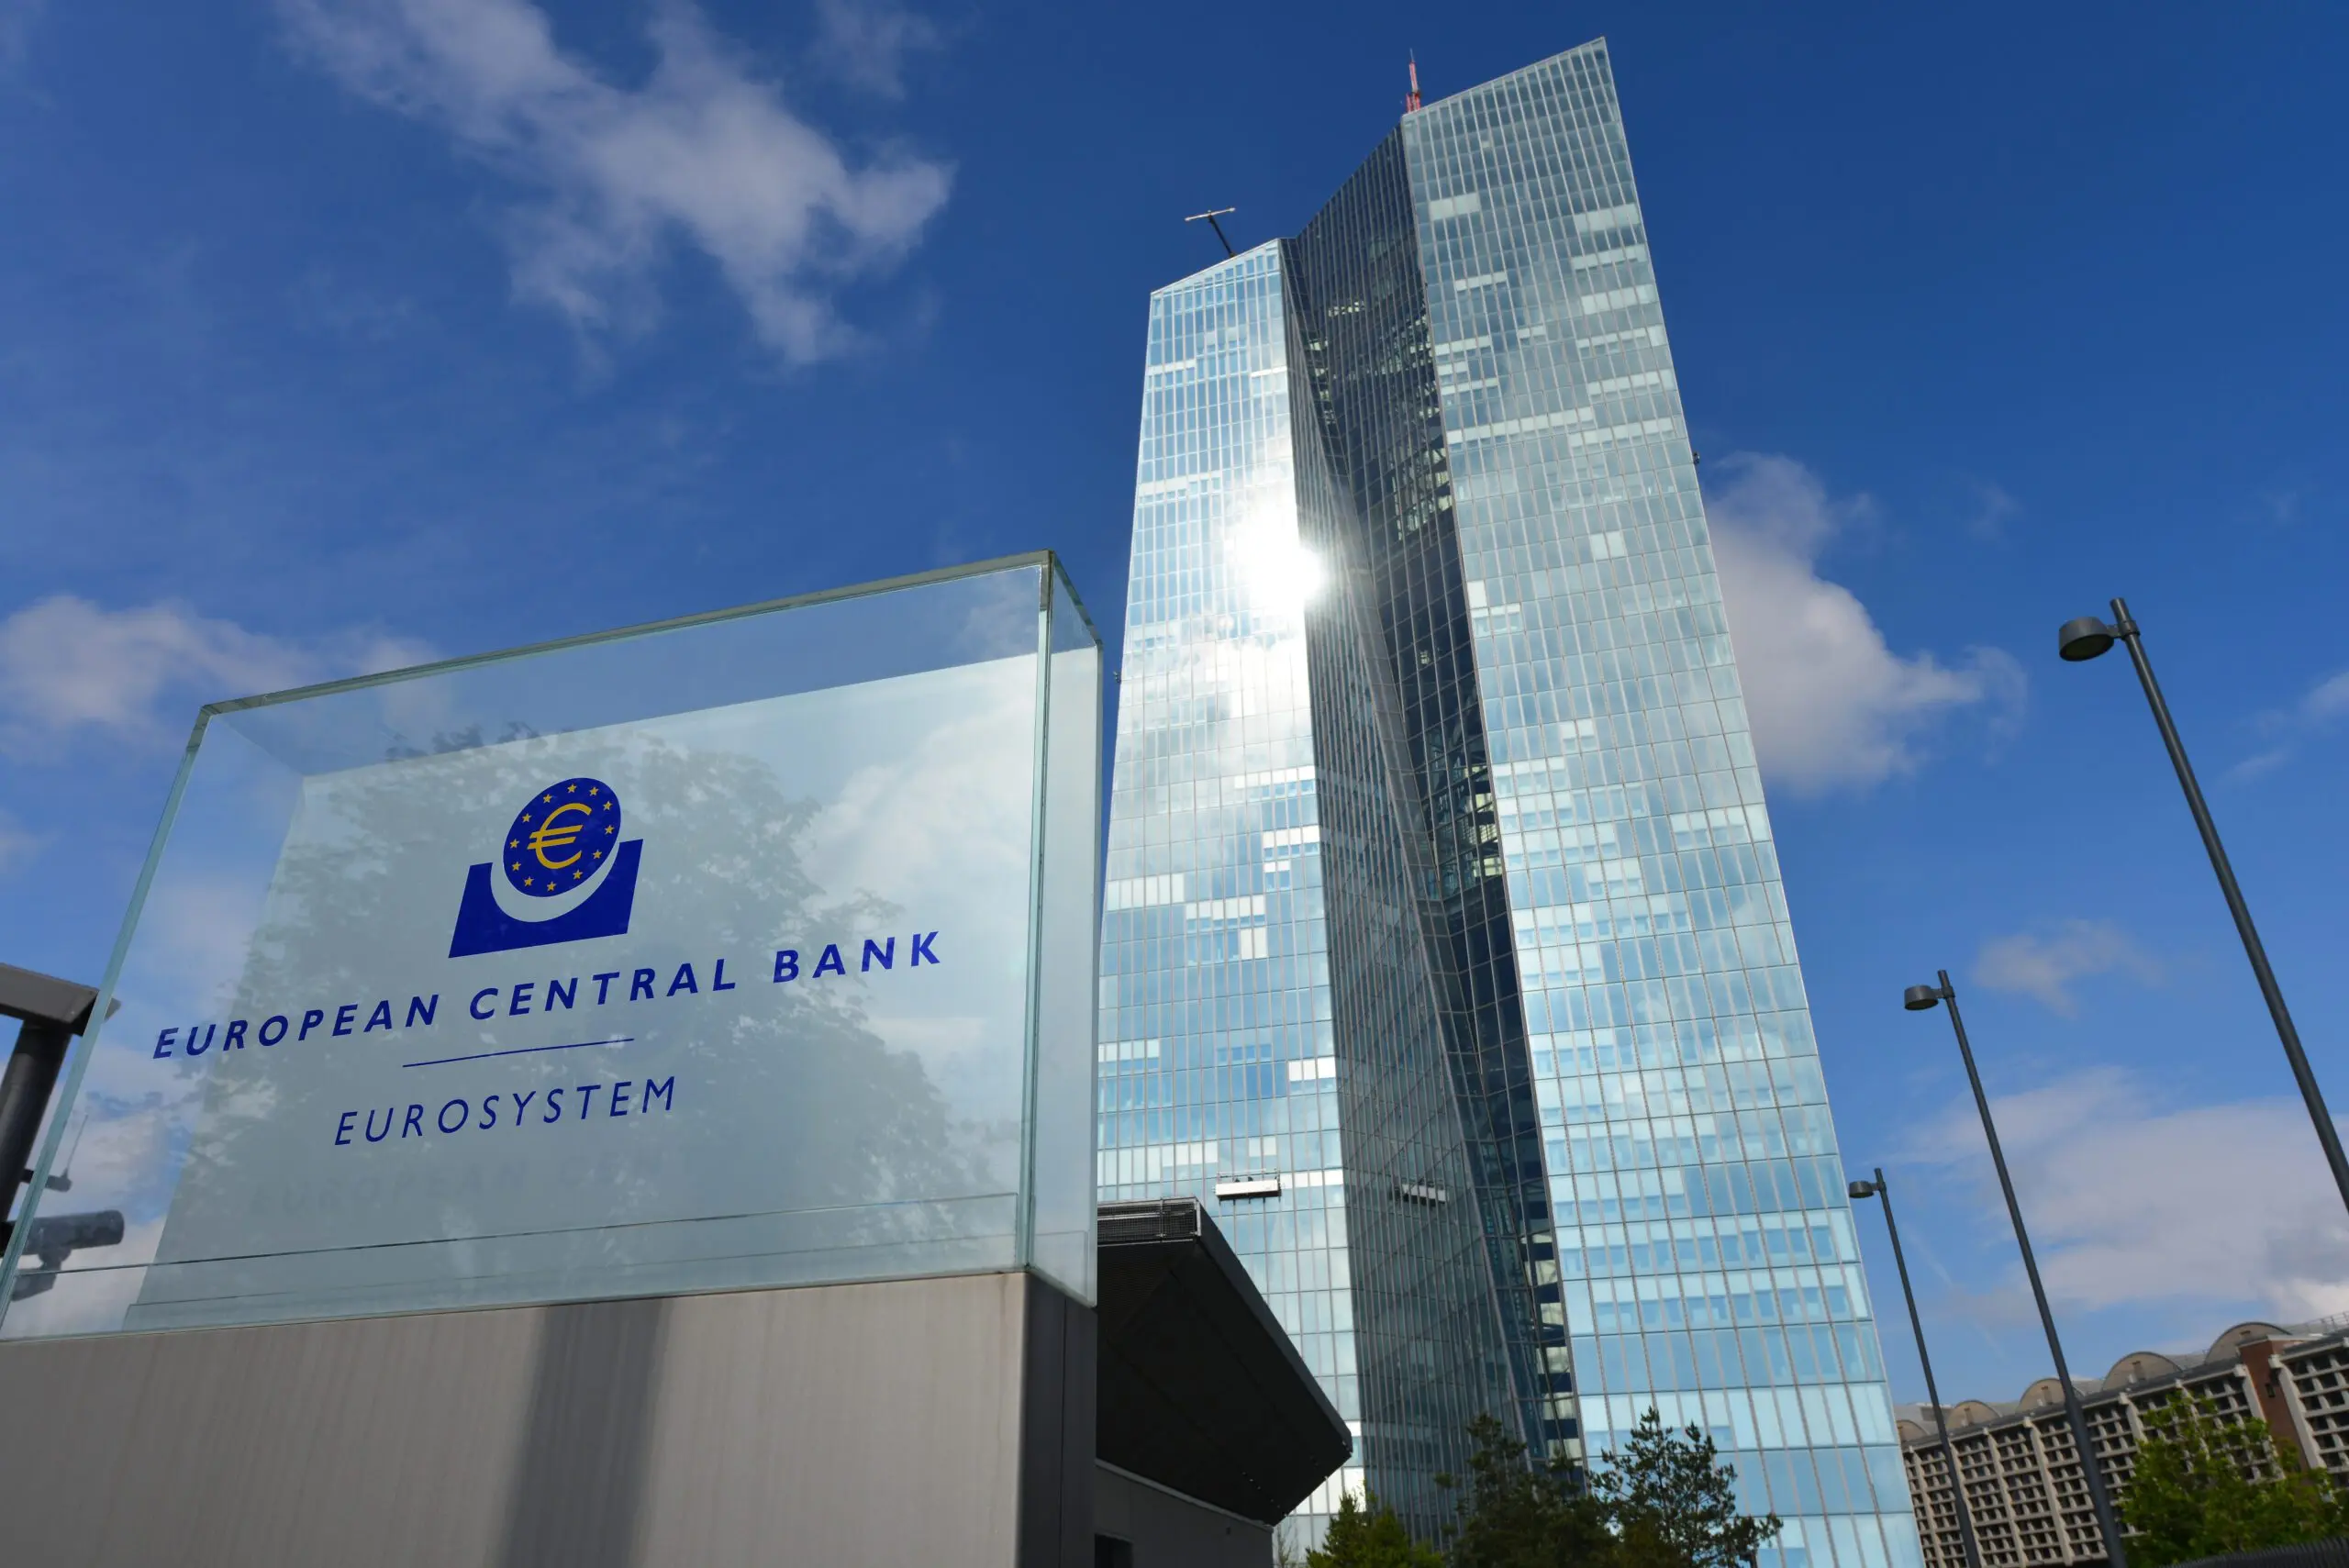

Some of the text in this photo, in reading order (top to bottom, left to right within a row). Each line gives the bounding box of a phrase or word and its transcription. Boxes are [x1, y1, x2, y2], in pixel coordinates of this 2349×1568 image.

[152, 931, 941, 1060] EUROPEAN CENTRAL BANK
[334, 1075, 675, 1146] EUROSYSTEM
